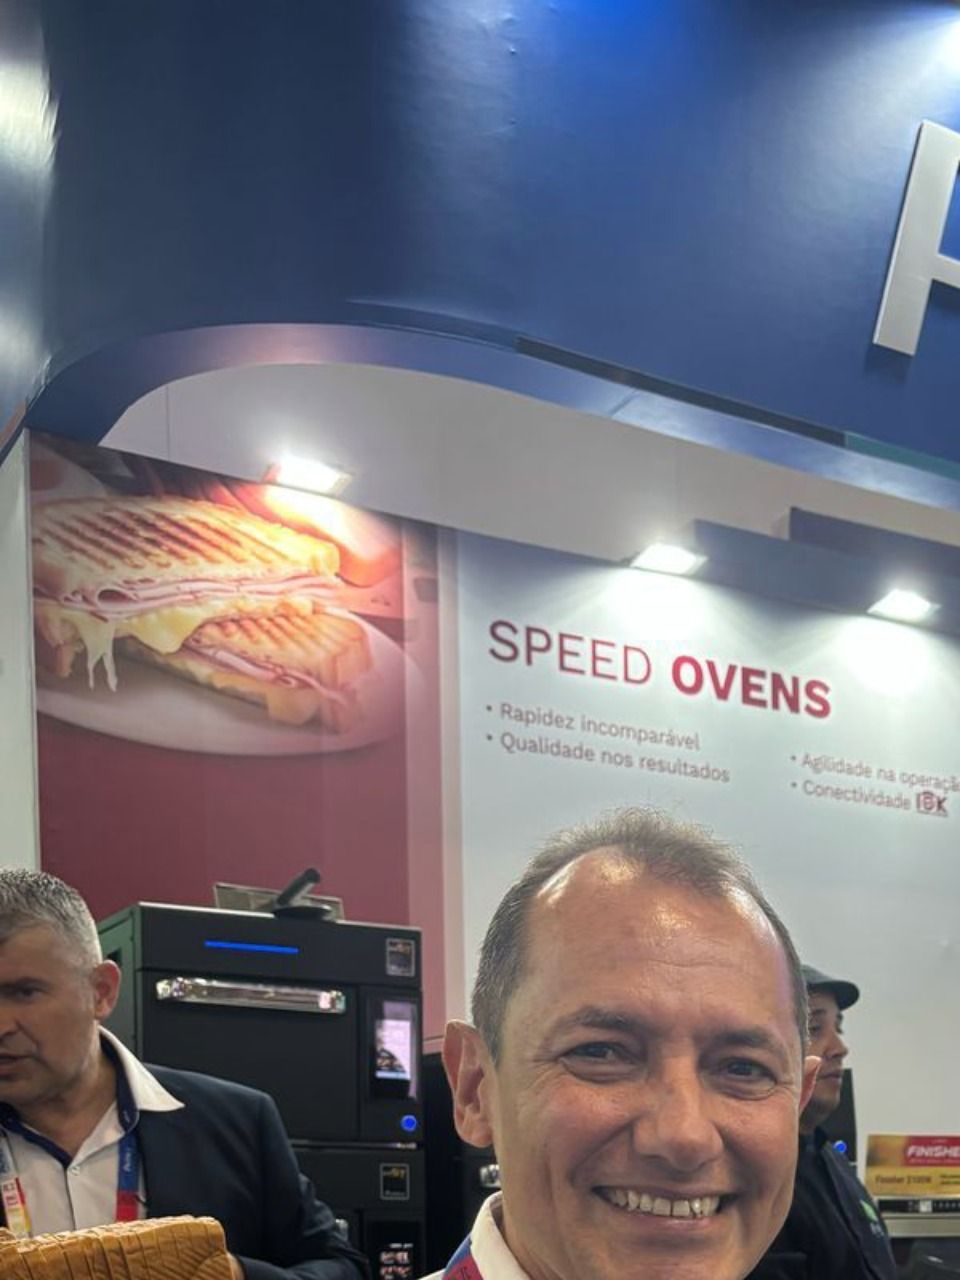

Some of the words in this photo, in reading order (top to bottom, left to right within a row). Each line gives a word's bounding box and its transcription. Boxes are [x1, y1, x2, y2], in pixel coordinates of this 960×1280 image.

[488, 620, 652, 685] SPEED
[671, 655, 831, 719] OVENS
[501, 703, 575, 727] Rapidez
[581, 715, 700, 750] incomparável
[500, 732, 595, 762] Qualidade
[601, 750, 633, 768] nos
[639, 756, 730, 783] resultados
[802, 754, 872, 778] Agilidade
[877, 767, 896, 782] na
[803, 779, 911, 810] Conectividade
